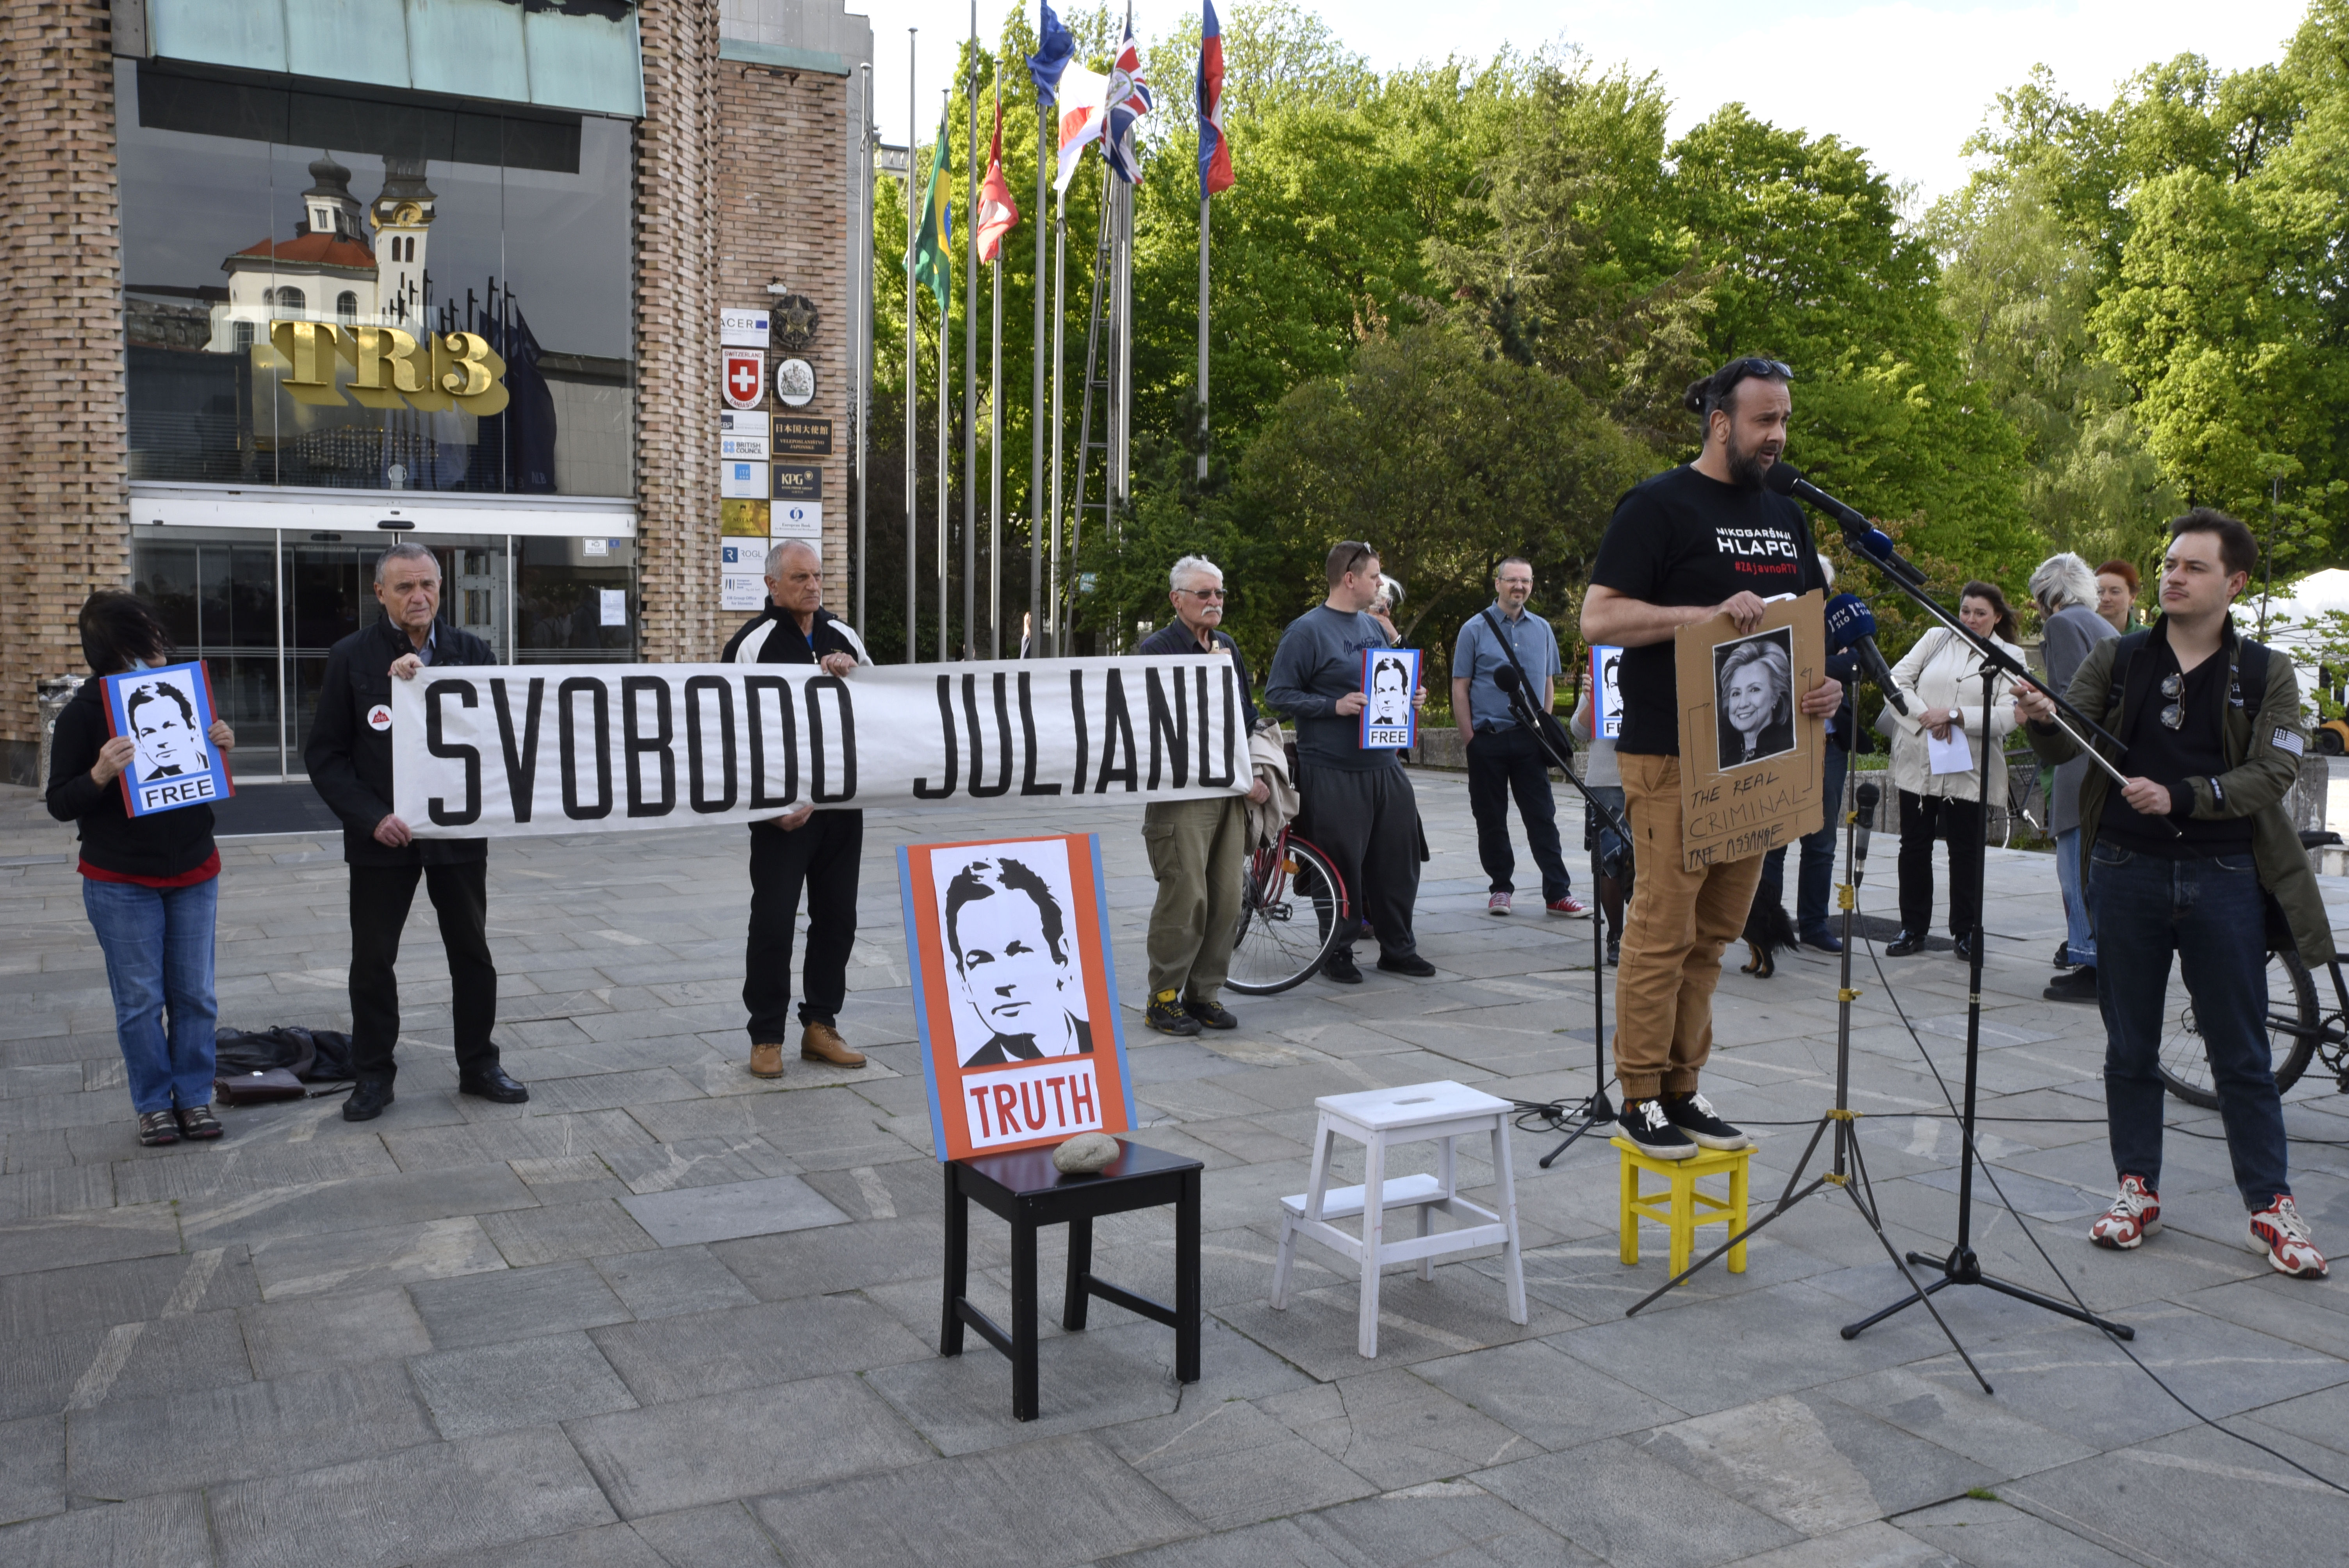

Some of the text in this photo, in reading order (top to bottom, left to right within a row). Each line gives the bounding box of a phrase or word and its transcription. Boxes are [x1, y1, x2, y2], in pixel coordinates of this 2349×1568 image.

[729, 398, 756, 408] EMBASSY
[776, 423, 829, 435] 日本国大使館
[781, 473, 803, 485] KPG
[1716, 527, 1791, 541] NIKOGARŠNJI
[1717, 537, 1798, 559] HLAPCI
[1735, 561, 1797, 576] #ZAjavnoRTV
[1832, 608, 1845, 622] RTV
[1836, 615, 1850, 629] SLO
[1371, 731, 1406, 743] FREE
[424, 666, 1235, 827] SVOBODO JULIANU
[145, 778, 214, 808] FREE
[1691, 772, 1780, 809] THE REAL
[1690, 784, 1807, 837] CRIMINAL
[1688, 842, 1722, 869] FREE
[970, 1072, 1096, 1139] TRUTH
